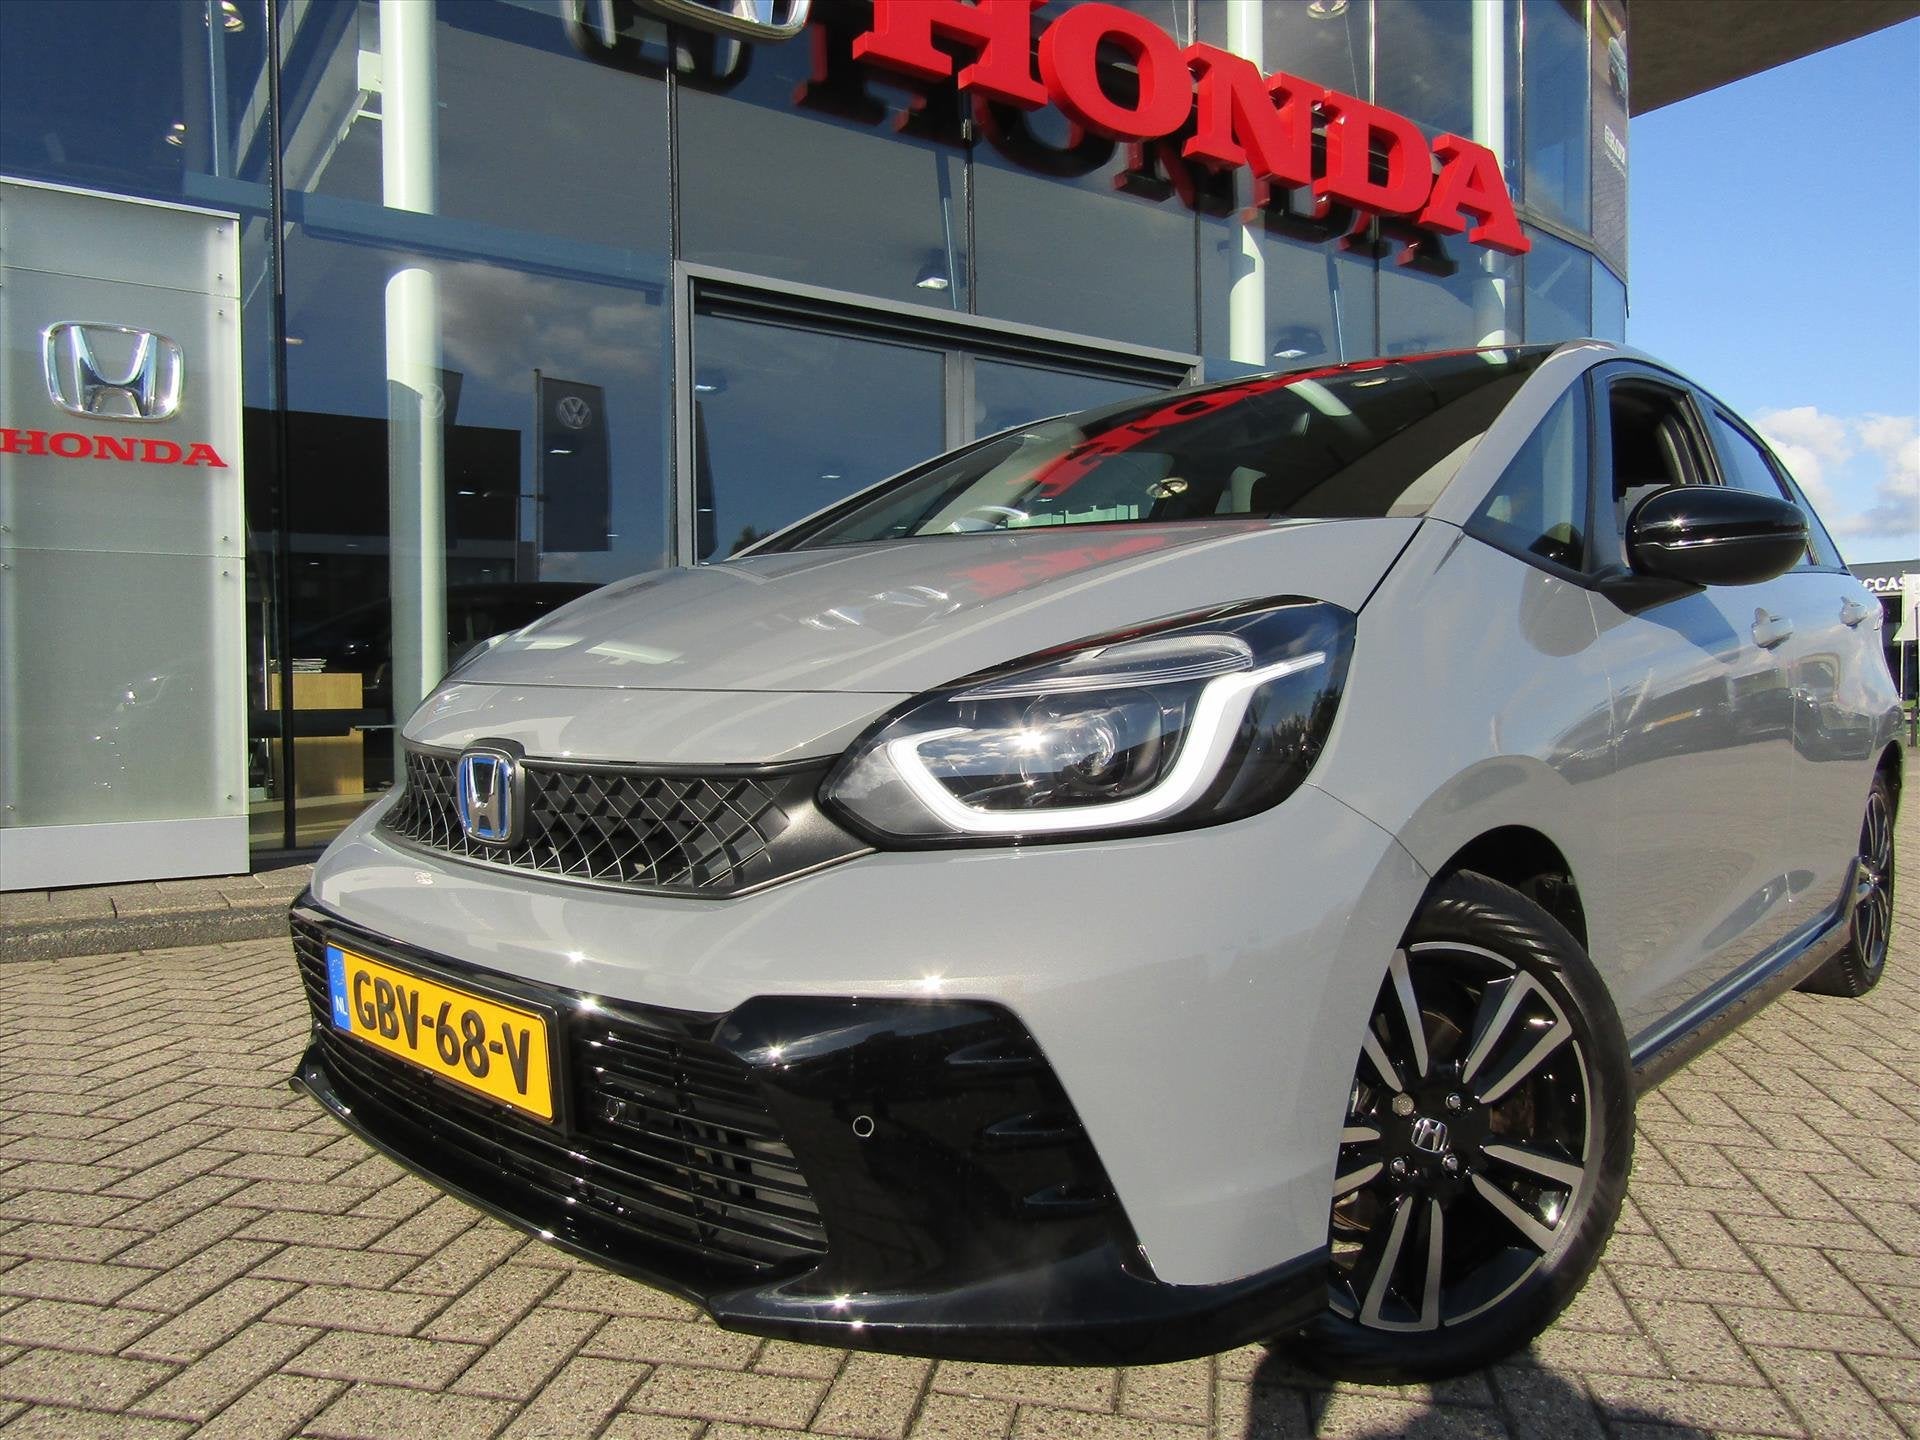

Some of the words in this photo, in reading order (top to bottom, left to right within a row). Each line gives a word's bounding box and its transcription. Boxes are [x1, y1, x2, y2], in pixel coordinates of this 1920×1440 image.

[852, 0, 1531, 256] HONDA
[0, 428, 229, 468] HONDA
[335, 995, 349, 1016] NL
[353, 969, 531, 1096] GBV-68-V
